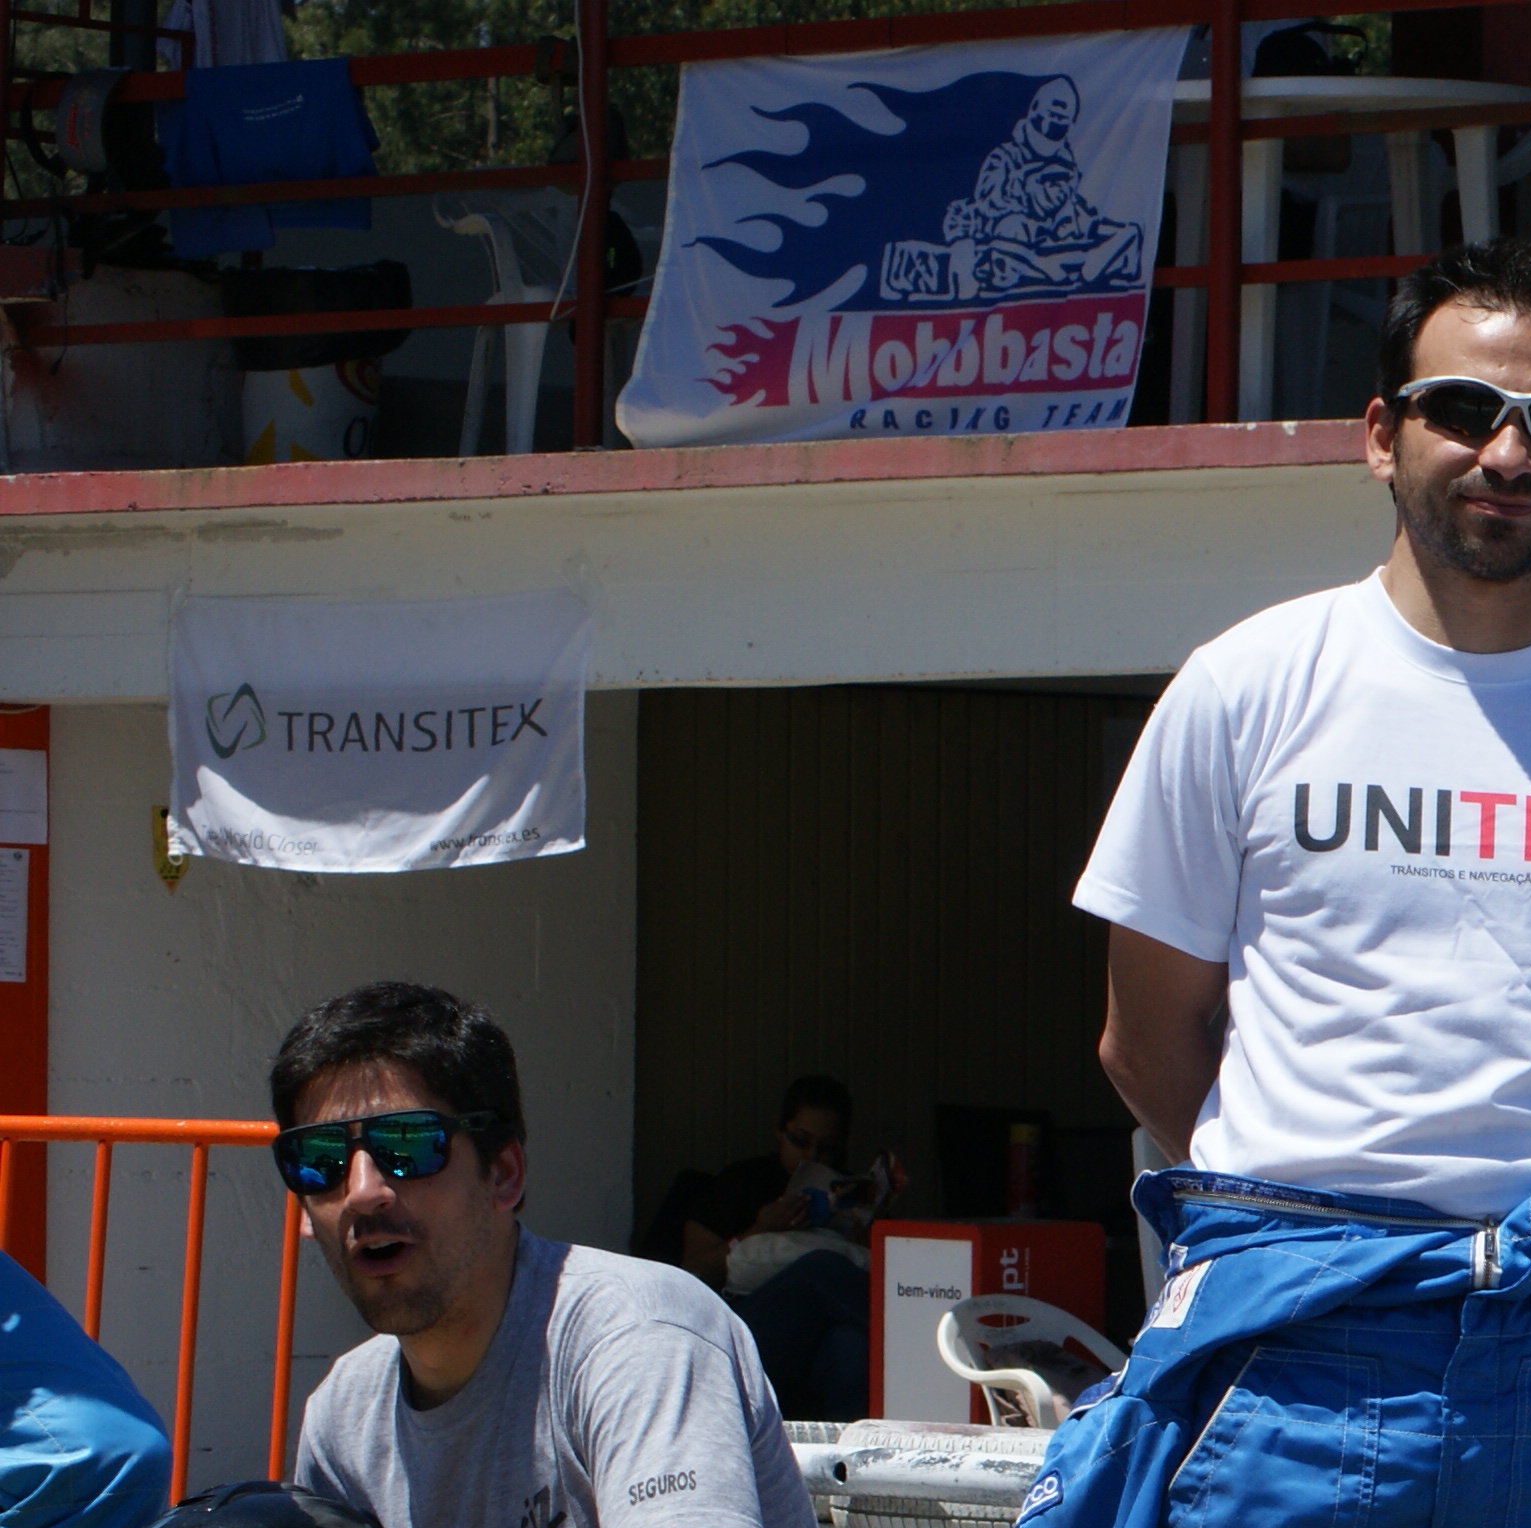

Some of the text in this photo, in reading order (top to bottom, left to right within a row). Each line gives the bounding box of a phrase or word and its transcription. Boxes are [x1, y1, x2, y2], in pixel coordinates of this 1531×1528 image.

[1042, 397, 1129, 427] TEAM
[277, 698, 548, 754] TRANSITEX
[1389, 863, 1456, 880] TRÂNSITOS
[1458, 870, 1466, 880] E
[896, 1282, 962, 1300] bem-vindo
[628, 1469, 698, 1506] SEGUROS
